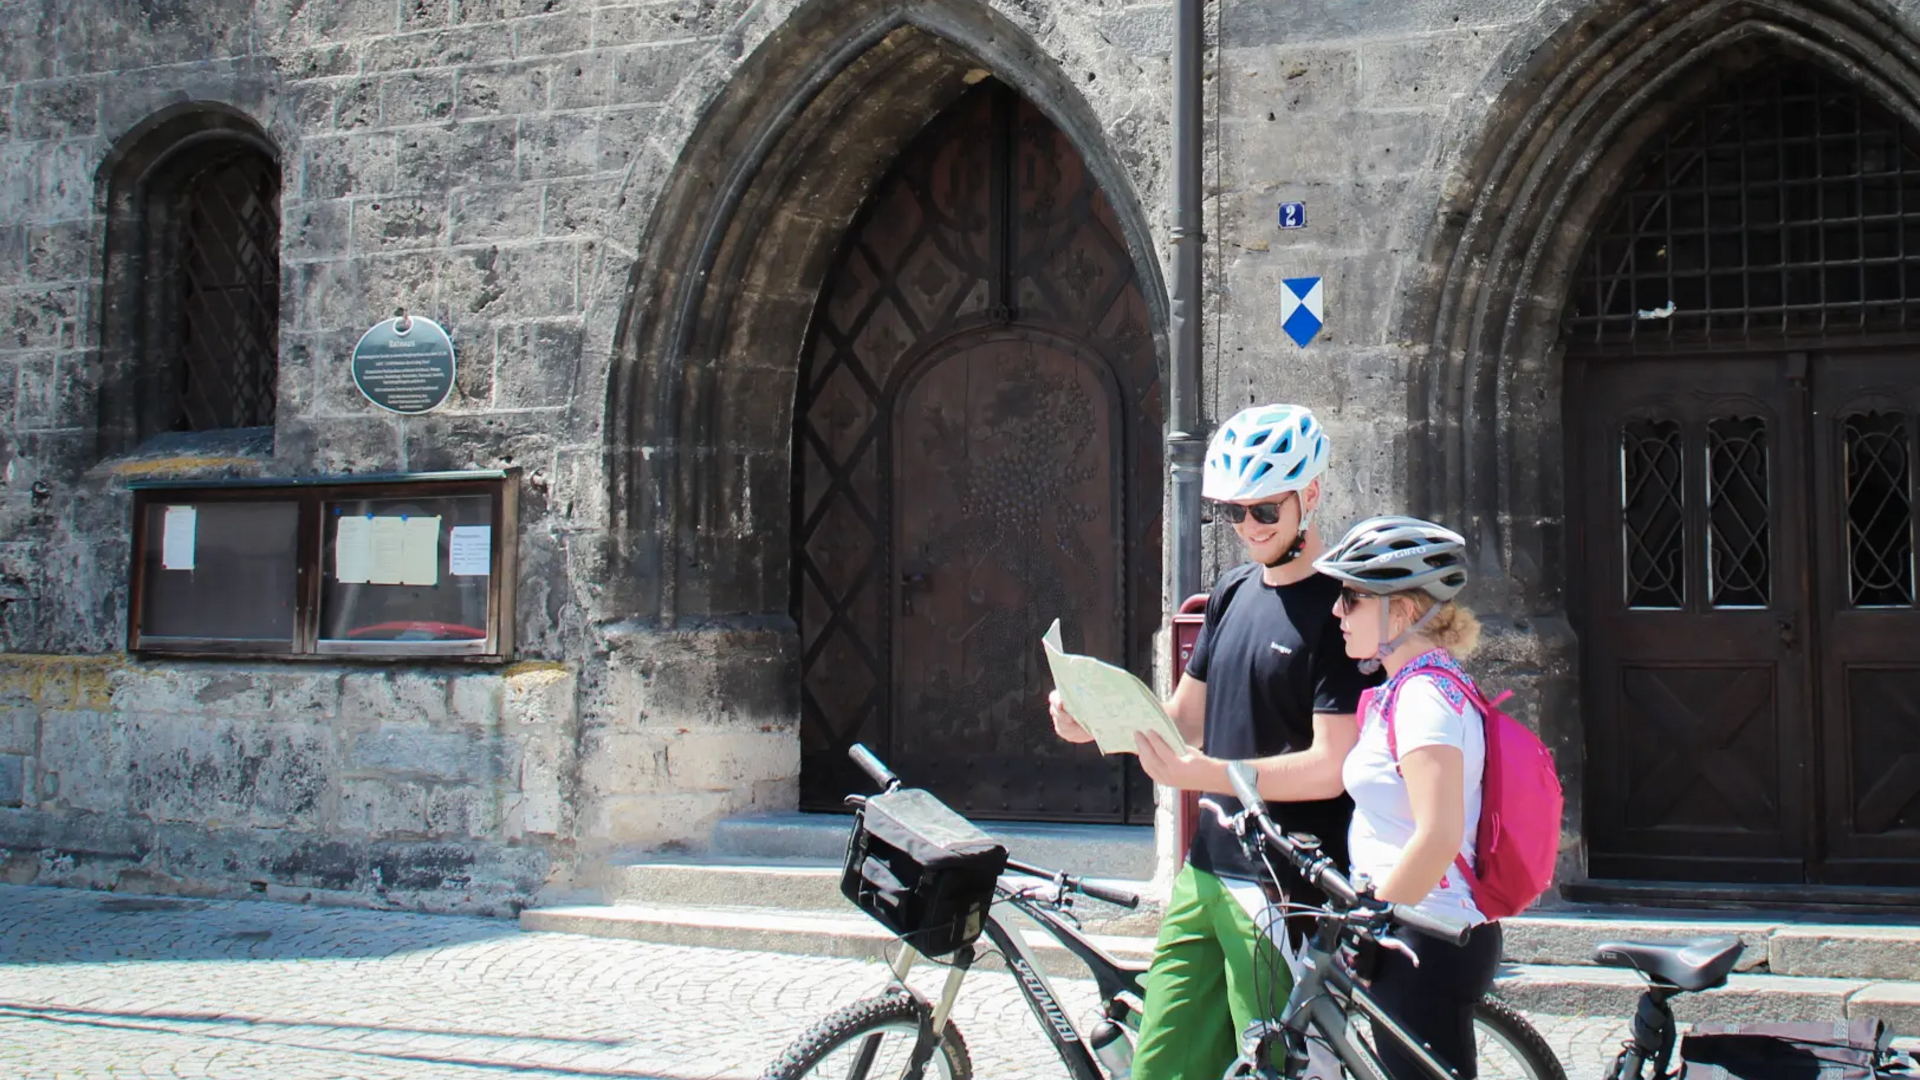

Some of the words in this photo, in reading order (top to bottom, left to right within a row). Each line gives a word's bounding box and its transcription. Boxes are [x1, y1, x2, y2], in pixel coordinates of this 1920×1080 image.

[1285, 205, 1296, 226] 2
[1394, 547, 1427, 558] GIRO
[1010, 958, 1079, 1043] SPECIALIZED
